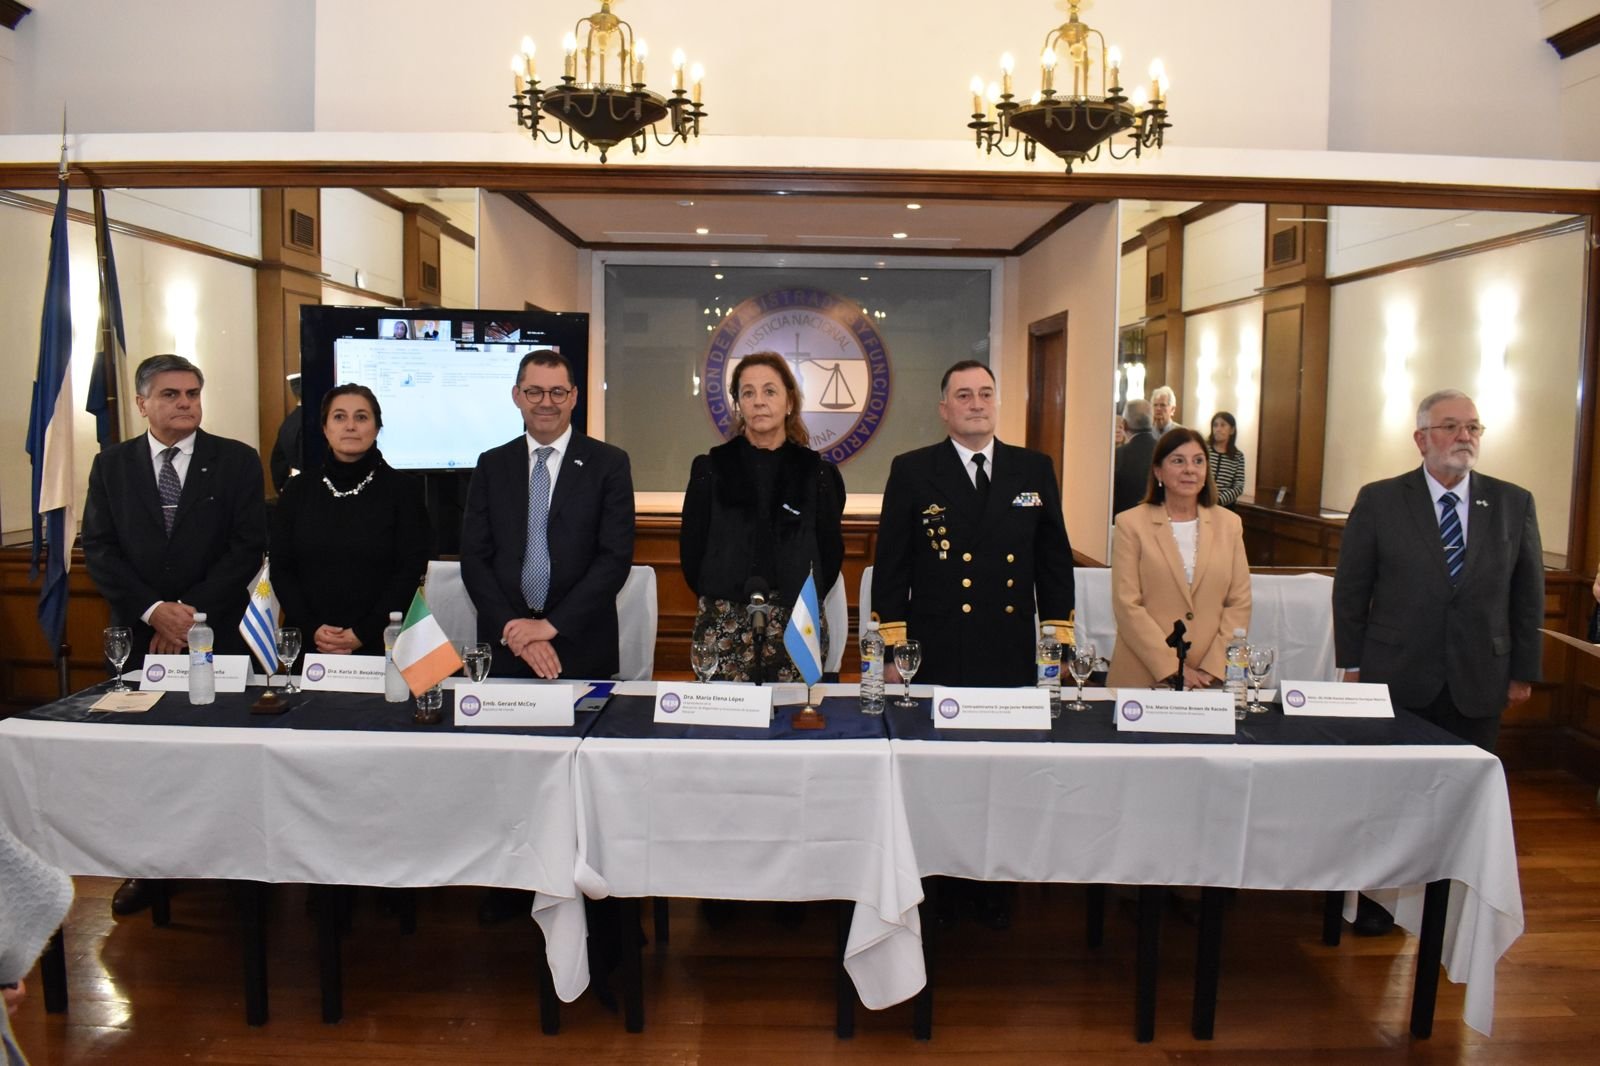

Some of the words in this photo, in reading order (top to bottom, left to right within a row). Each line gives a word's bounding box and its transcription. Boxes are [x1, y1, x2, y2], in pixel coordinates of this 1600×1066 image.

[746, 314, 791, 350] JUSTICIA
[792, 314, 851, 352] NACIONAL
[856, 321, 870, 333] Y
[712, 336, 729, 362] DE
[820, 338, 888, 462] FUNCIONARIOS
[176, 668, 191, 676] Dieg
